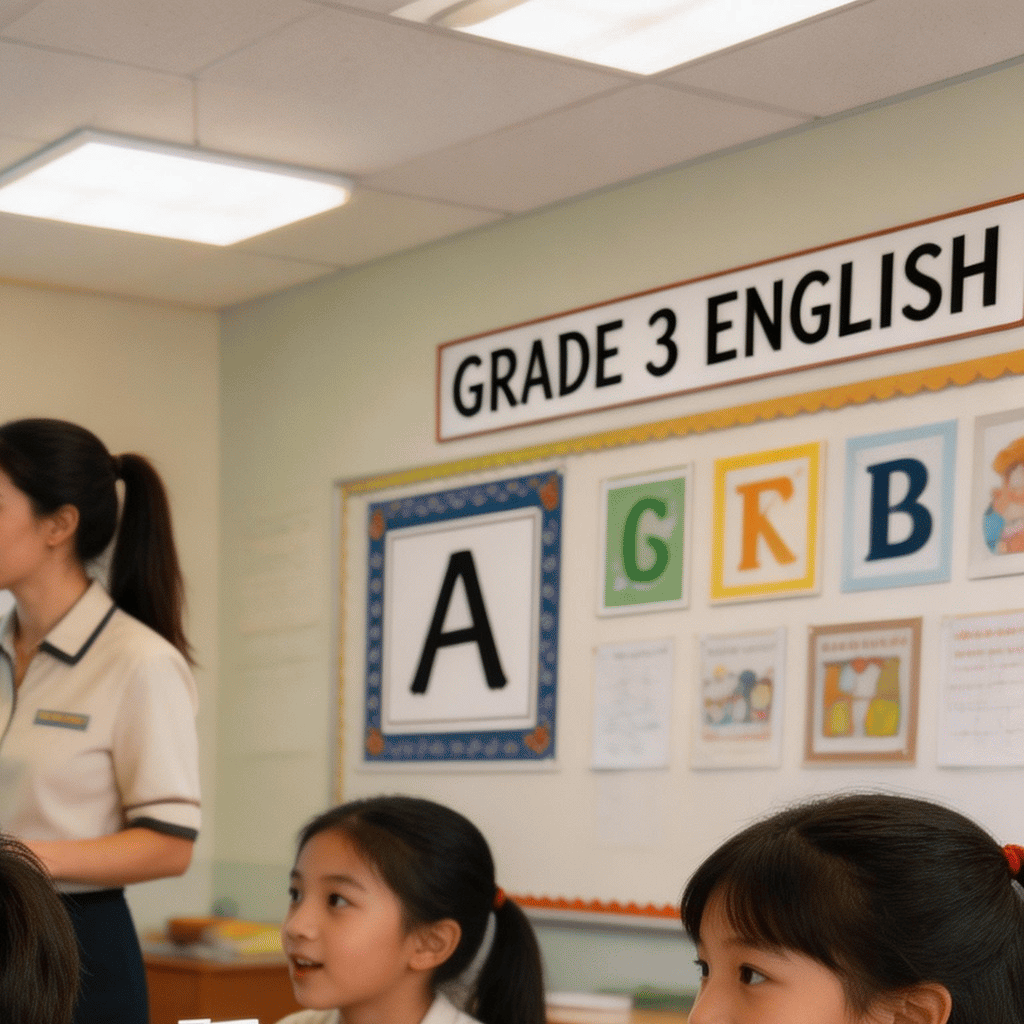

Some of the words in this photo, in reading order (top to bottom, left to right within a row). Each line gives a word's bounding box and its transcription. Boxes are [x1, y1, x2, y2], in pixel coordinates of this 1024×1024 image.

[452, 319, 624, 418] GRADE
[645, 307, 679, 377] 3
[705, 225, 1000, 366] ENGLISH
[622, 499, 670, 584] G
[865, 458, 933, 562] B
[409, 549, 508, 695] A
